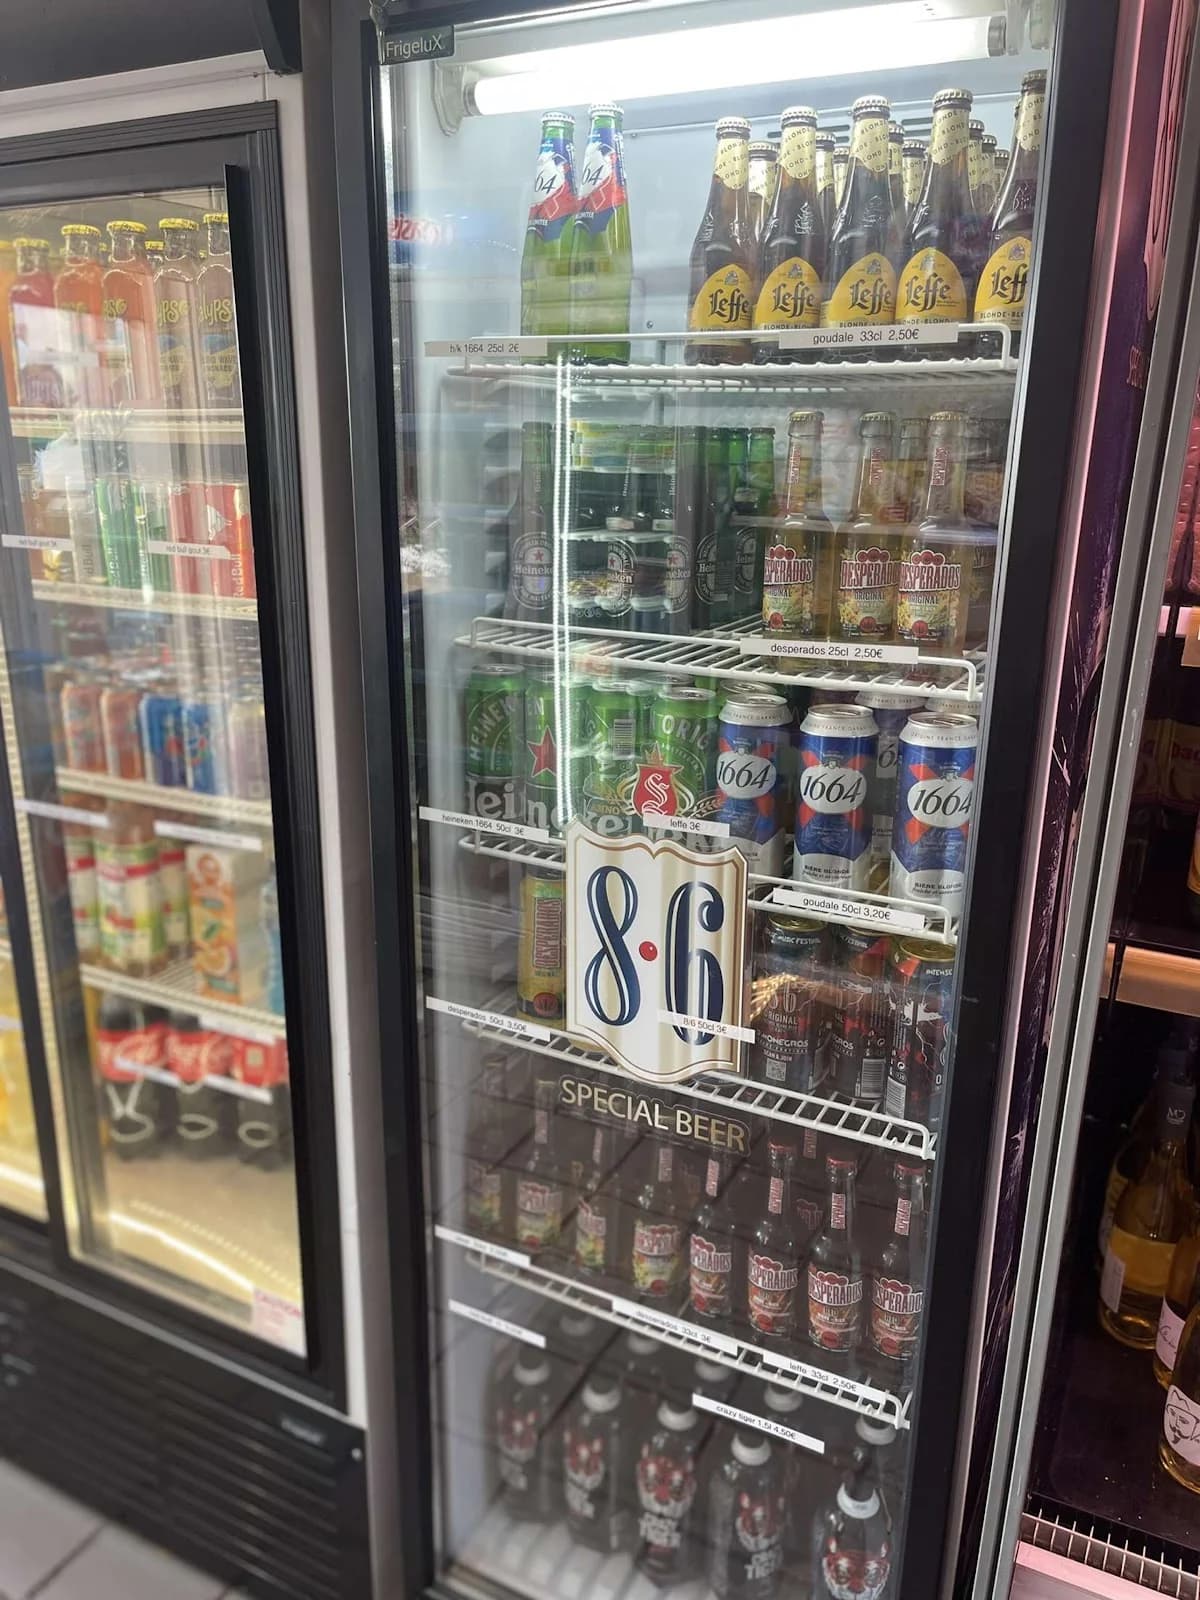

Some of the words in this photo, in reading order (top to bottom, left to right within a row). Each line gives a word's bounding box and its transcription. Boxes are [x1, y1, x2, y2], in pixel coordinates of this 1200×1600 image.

[709, 287, 750, 324] Leffe
[772, 280, 816, 319] Leffe
[848, 277, 892, 316] Leffe
[904, 271, 951, 312] Leffe
[487, 342, 504, 353] 25cl
[508, 342, 520, 353] 2€
[813, 331, 854, 346] goudale
[860, 330, 882, 343] 33cl
[771, 643, 826, 657] desperados
[828, 645, 849, 657] 25cl
[854, 647, 883, 660] 2,50€
[718, 759, 770, 790] 1664
[803, 772, 861, 804] 1664
[689, 820, 701, 832] 3€
[803, 896, 839, 911] goudale
[842, 902, 861, 915] 50cl
[697, 1020, 716, 1032] 50cl
[717, 1024, 729, 1035] 3€
[559, 1080, 669, 1131] SPECIAL
[675, 1110, 748, 1153] BEER
